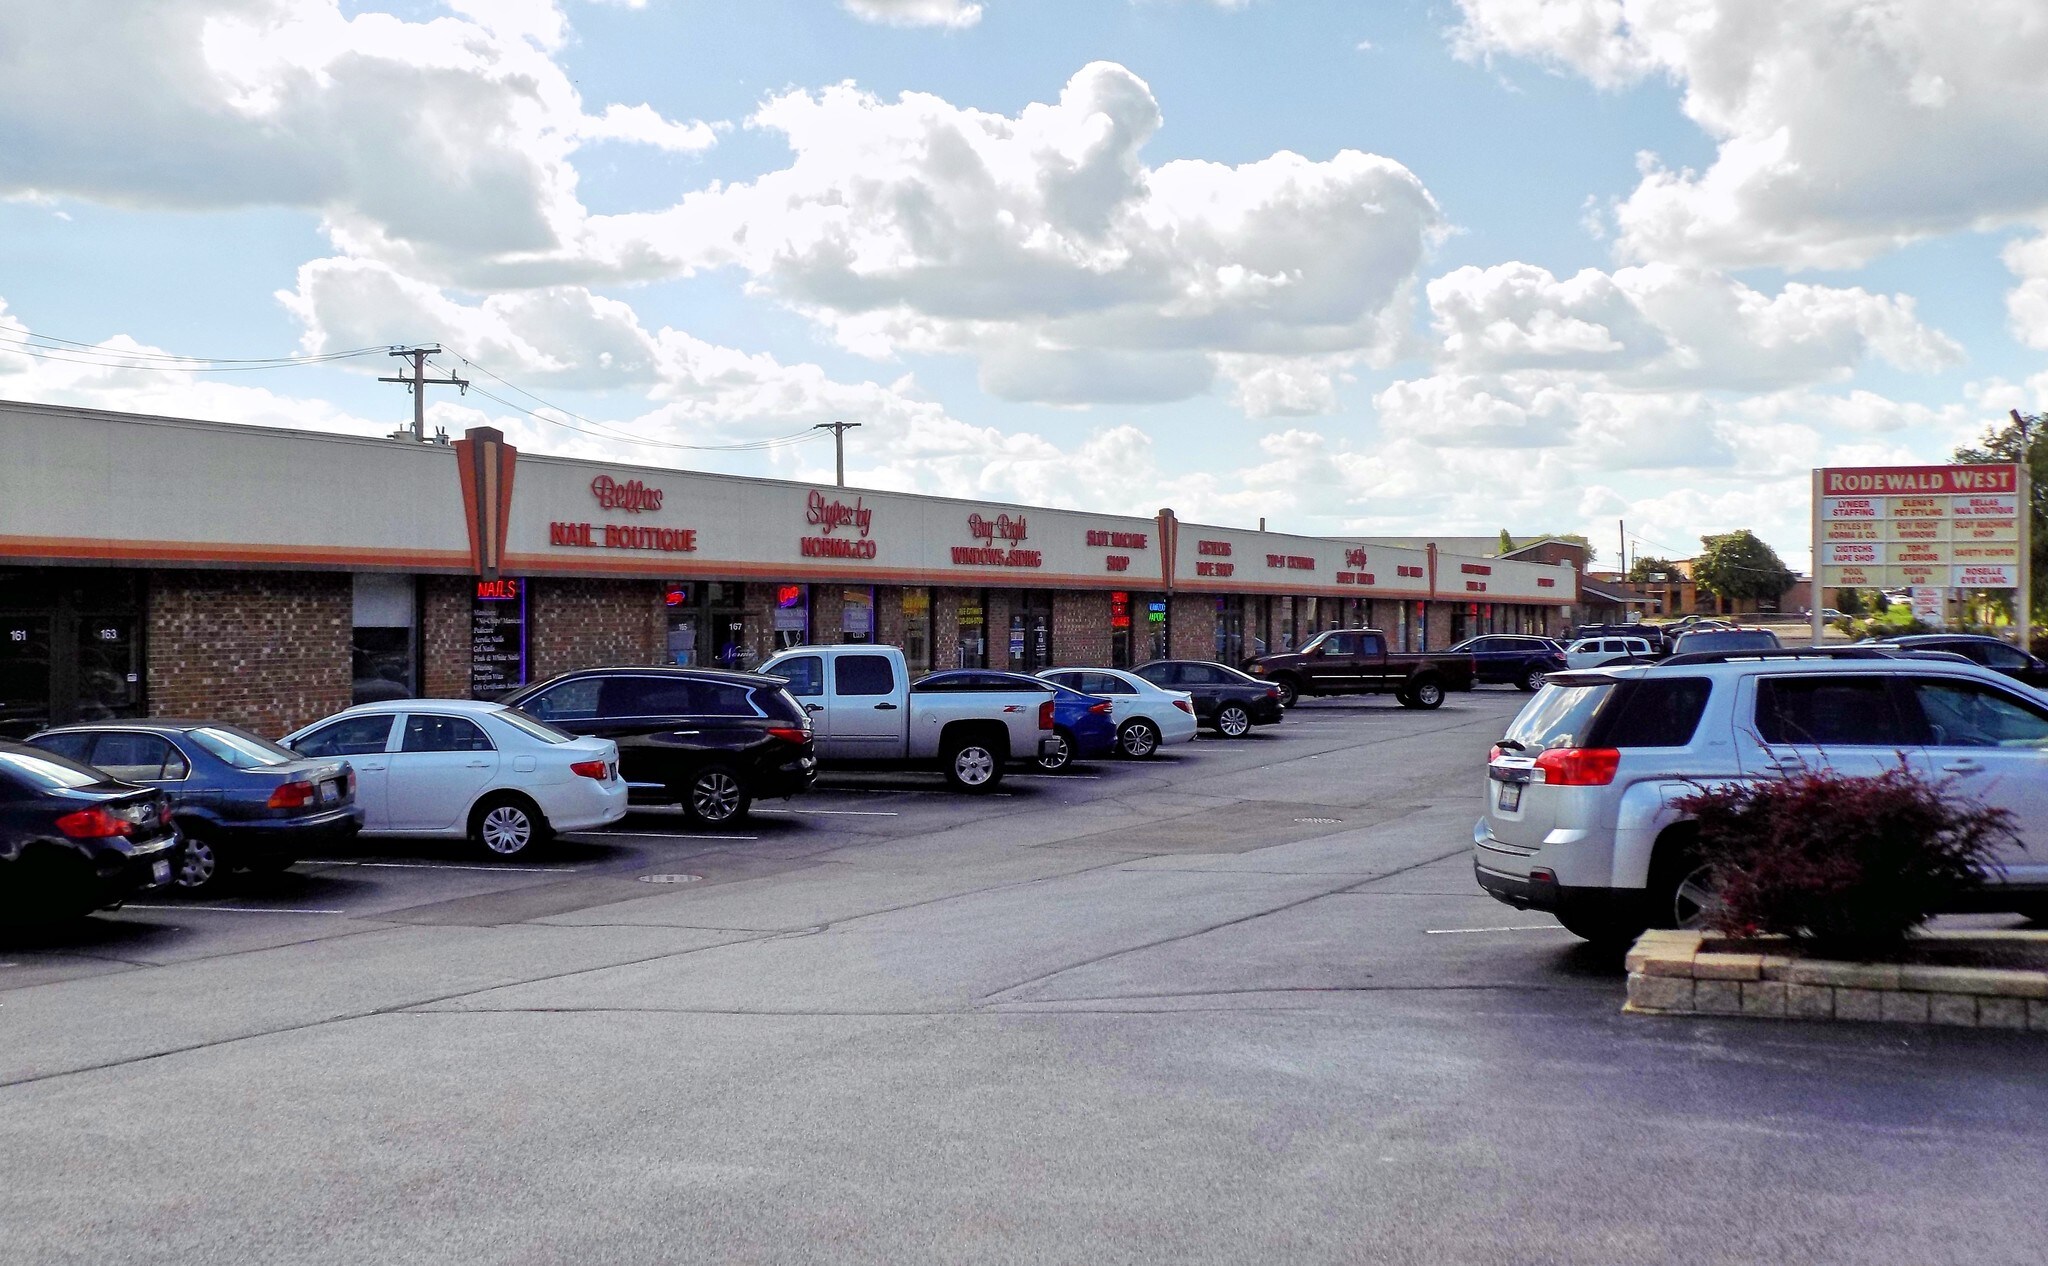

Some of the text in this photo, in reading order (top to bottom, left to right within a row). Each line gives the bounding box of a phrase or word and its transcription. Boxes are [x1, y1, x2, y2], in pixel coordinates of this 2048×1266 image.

[1830, 470, 2010, 491] RODEWALD WEST
[591, 474, 663, 513] Bellas
[806, 489, 872, 537] Styles by
[1832, 508, 1875, 517] STAFFING
[1894, 508, 1943, 516] PET STYLING
[1974, 506, 2014, 514] BOUTIQUE
[968, 512, 994, 547] Buy
[1833, 522, 1874, 530] STYLES BY
[550, 521, 698, 552] NAIL BOUTIQUE
[1086, 529, 1109, 547] SLOT
[1828, 531, 1856, 539] NORMA
[1899, 530, 1937, 539] WINDOWS
[1973, 530, 1995, 538] SHOP
[801, 536, 851, 557] NORMA
[951, 546, 1005, 566] WINDOWS
[1106, 555, 1130, 571] SHOP
[1965, 567, 2002, 575] ROSELLE
[1961, 576, 1976, 584] EYE
[477, 580, 516, 598] NAILS
[728, 622, 743, 631] 167
[10, 630, 27, 641] 161
[100, 629, 117, 639] 163
